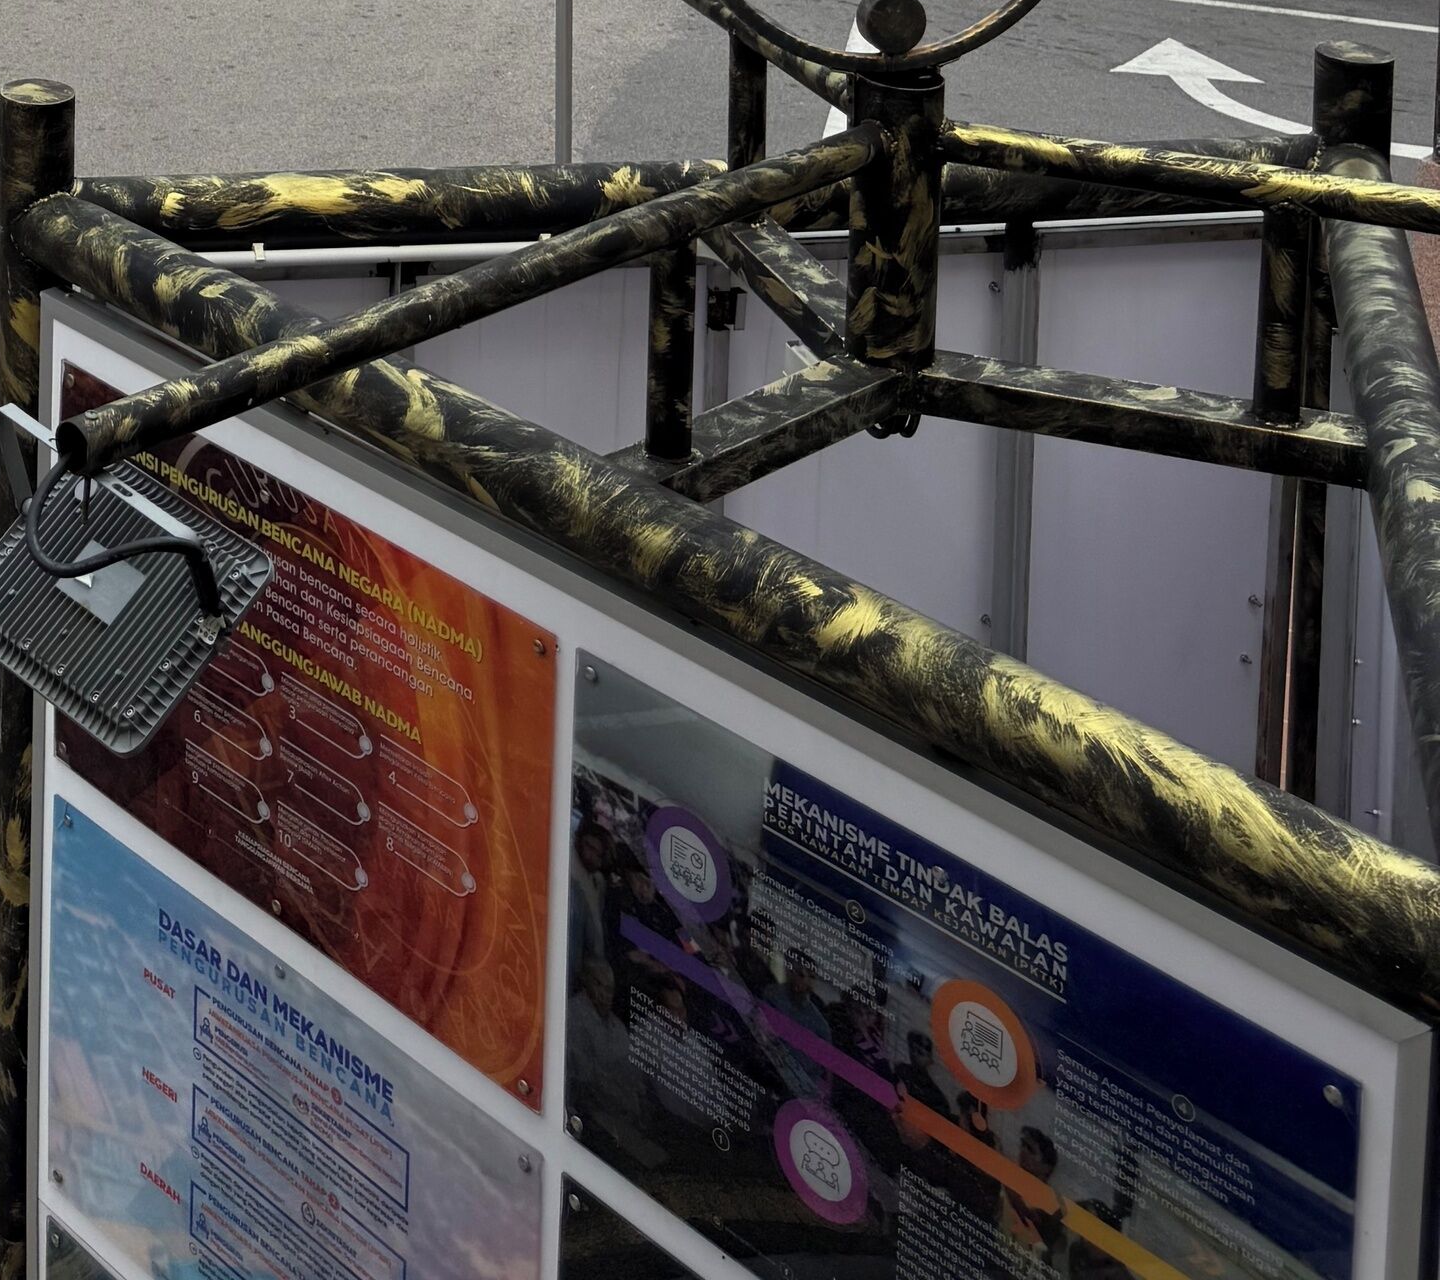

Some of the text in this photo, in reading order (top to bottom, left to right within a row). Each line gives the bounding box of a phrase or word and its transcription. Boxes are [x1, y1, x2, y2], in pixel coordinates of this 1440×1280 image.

[161, 460, 258, 531] PENGURUSAN
[261, 519, 336, 577] BENCANA
[339, 564, 403, 617] NEGARA
[407, 599, 482, 663] (NADMA)
[265, 586, 432, 700] Bencana serta perancangan
[266, 605, 357, 671] Pasca Bencana.
[299, 568, 352, 609] bencana
[355, 601, 396, 635] secara
[399, 626, 441, 662] holistik
[300, 587, 475, 704] dan Kesiapsiagaan Bencana,
[193, 708, 200, 724] 6
[288, 705, 295, 720] 3
[364, 696, 421, 744] NADMA
[191, 770, 198, 786] 9
[287, 769, 294, 784] 7
[388, 769, 396, 785] 4
[278, 828, 291, 849] 10
[386, 836, 394, 852] 8
[764, 777, 890, 862] MEKANISME
[989, 905, 1068, 964] BALAS
[763, 794, 1067, 981] PERINTAH DAN KAWALAN
[764, 810, 795, 837] (POS
[800, 831, 868, 879] KAWALAN
[872, 873, 928, 914] TEMPAT
[1013, 956, 1064, 994] (PKTK)
[143, 967, 175, 1001] PUSAT
[158, 927, 285, 1038] PENGURUSAN
[158, 907, 394, 1104] DASAR DAN MEKANISME
[142, 1066, 177, 1103] NEGERI
[212, 996, 329, 1094] PENGURUSAN BENCANA TAHAP
[1056, 1062, 1253, 1191] Agensi Bantuan dan Pemulihan
[1056, 1076, 1255, 1208] yang terlibat dalam pengurusan
[1057, 1048, 1250, 1174] Semua Agensi Penyelamat dan
[140, 1161, 180, 1206] DAERAH
